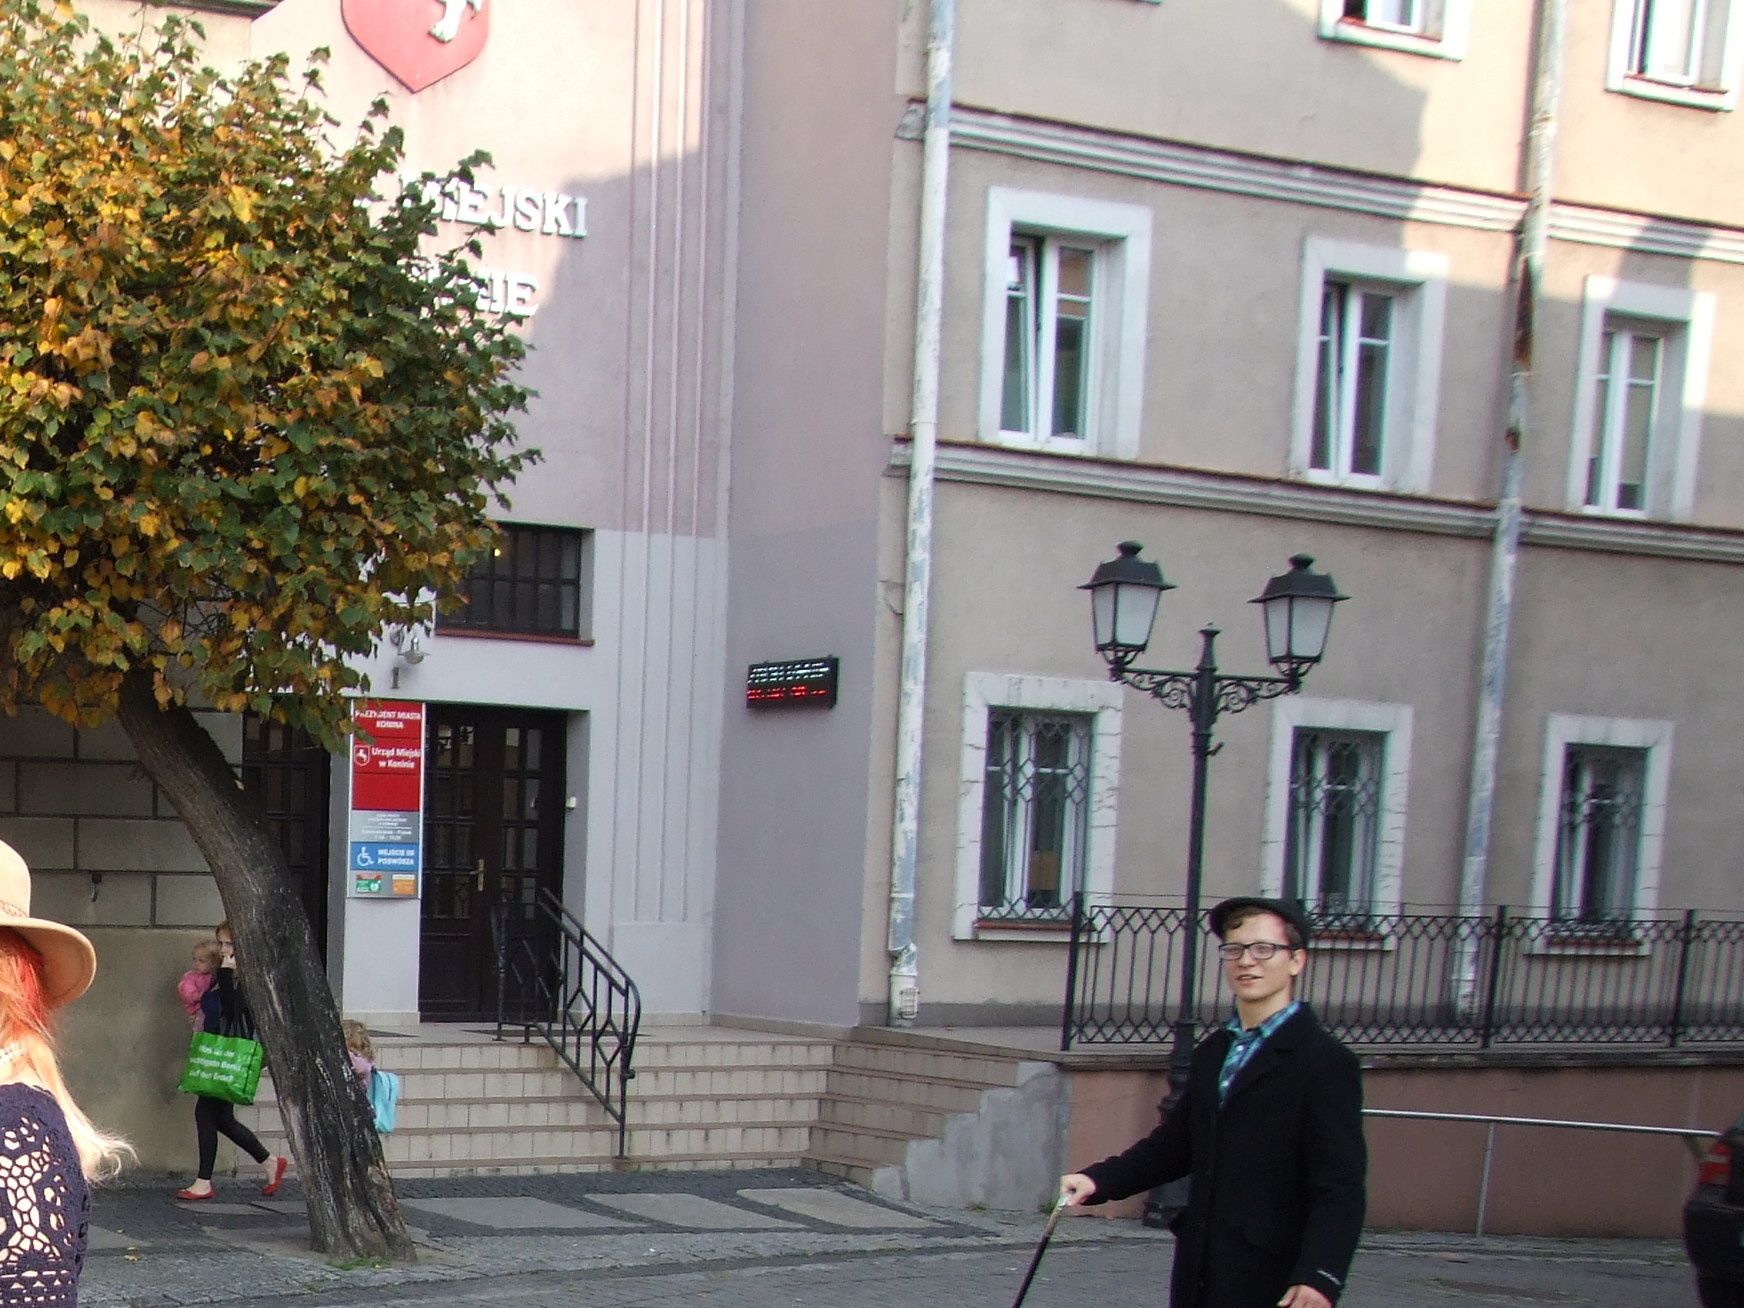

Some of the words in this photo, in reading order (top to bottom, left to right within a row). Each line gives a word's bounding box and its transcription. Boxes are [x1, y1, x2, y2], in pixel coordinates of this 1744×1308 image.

[397, 711, 422, 720] MIASTA
[376, 719, 404, 729] KONINA
[371, 747, 396, 758] Urząd
[378, 760, 387, 768] w
[387, 759, 415, 769] Koninie
